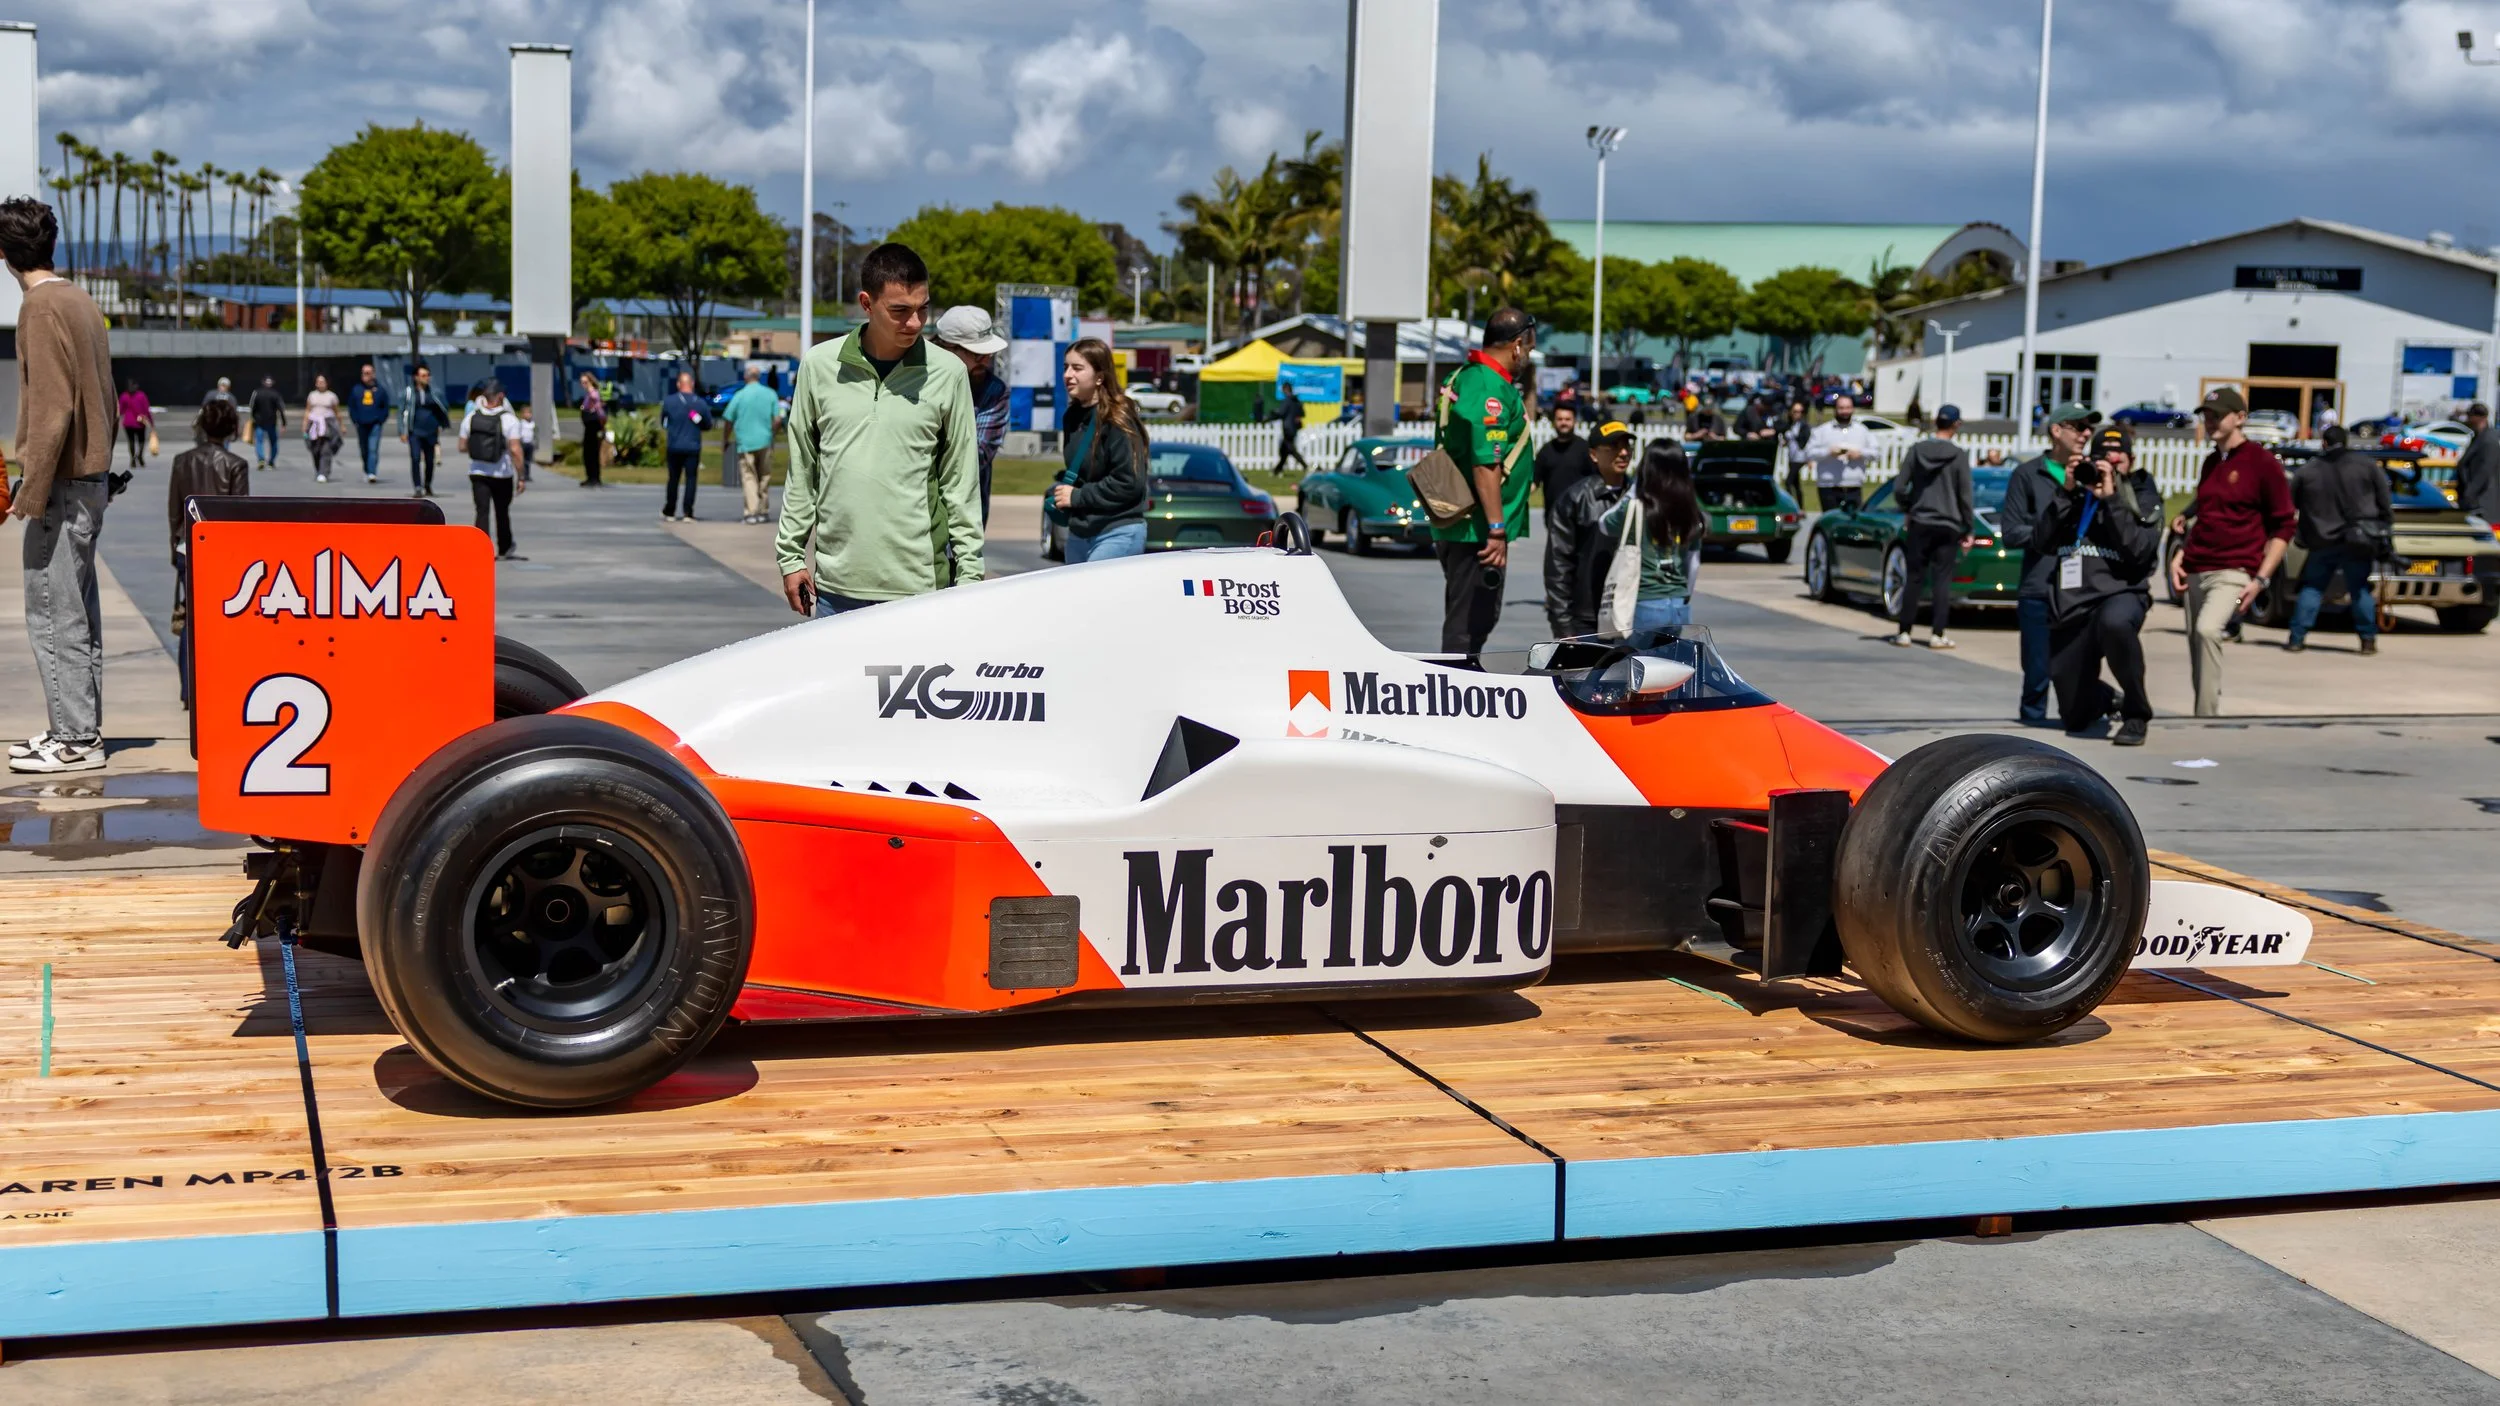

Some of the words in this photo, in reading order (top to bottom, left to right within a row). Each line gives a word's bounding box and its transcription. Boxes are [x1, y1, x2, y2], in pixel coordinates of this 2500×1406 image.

[223, 547, 457, 620] SAIMA
[1218, 578, 1280, 598] Prost
[1223, 599, 1280, 616] BOSS
[865, 662, 975, 720] TAG
[976, 662, 1045, 679] turbo
[1343, 671, 1527, 720] Marlboro
[239, 672, 332, 796] 2
[1926, 770, 2020, 866] AVON
[1120, 844, 1552, 976] Marlboro
[2134, 933, 2284, 957] OODYEAR
[650, 896, 739, 1055] AVON
[24, 1211, 74, 1219] ONE
